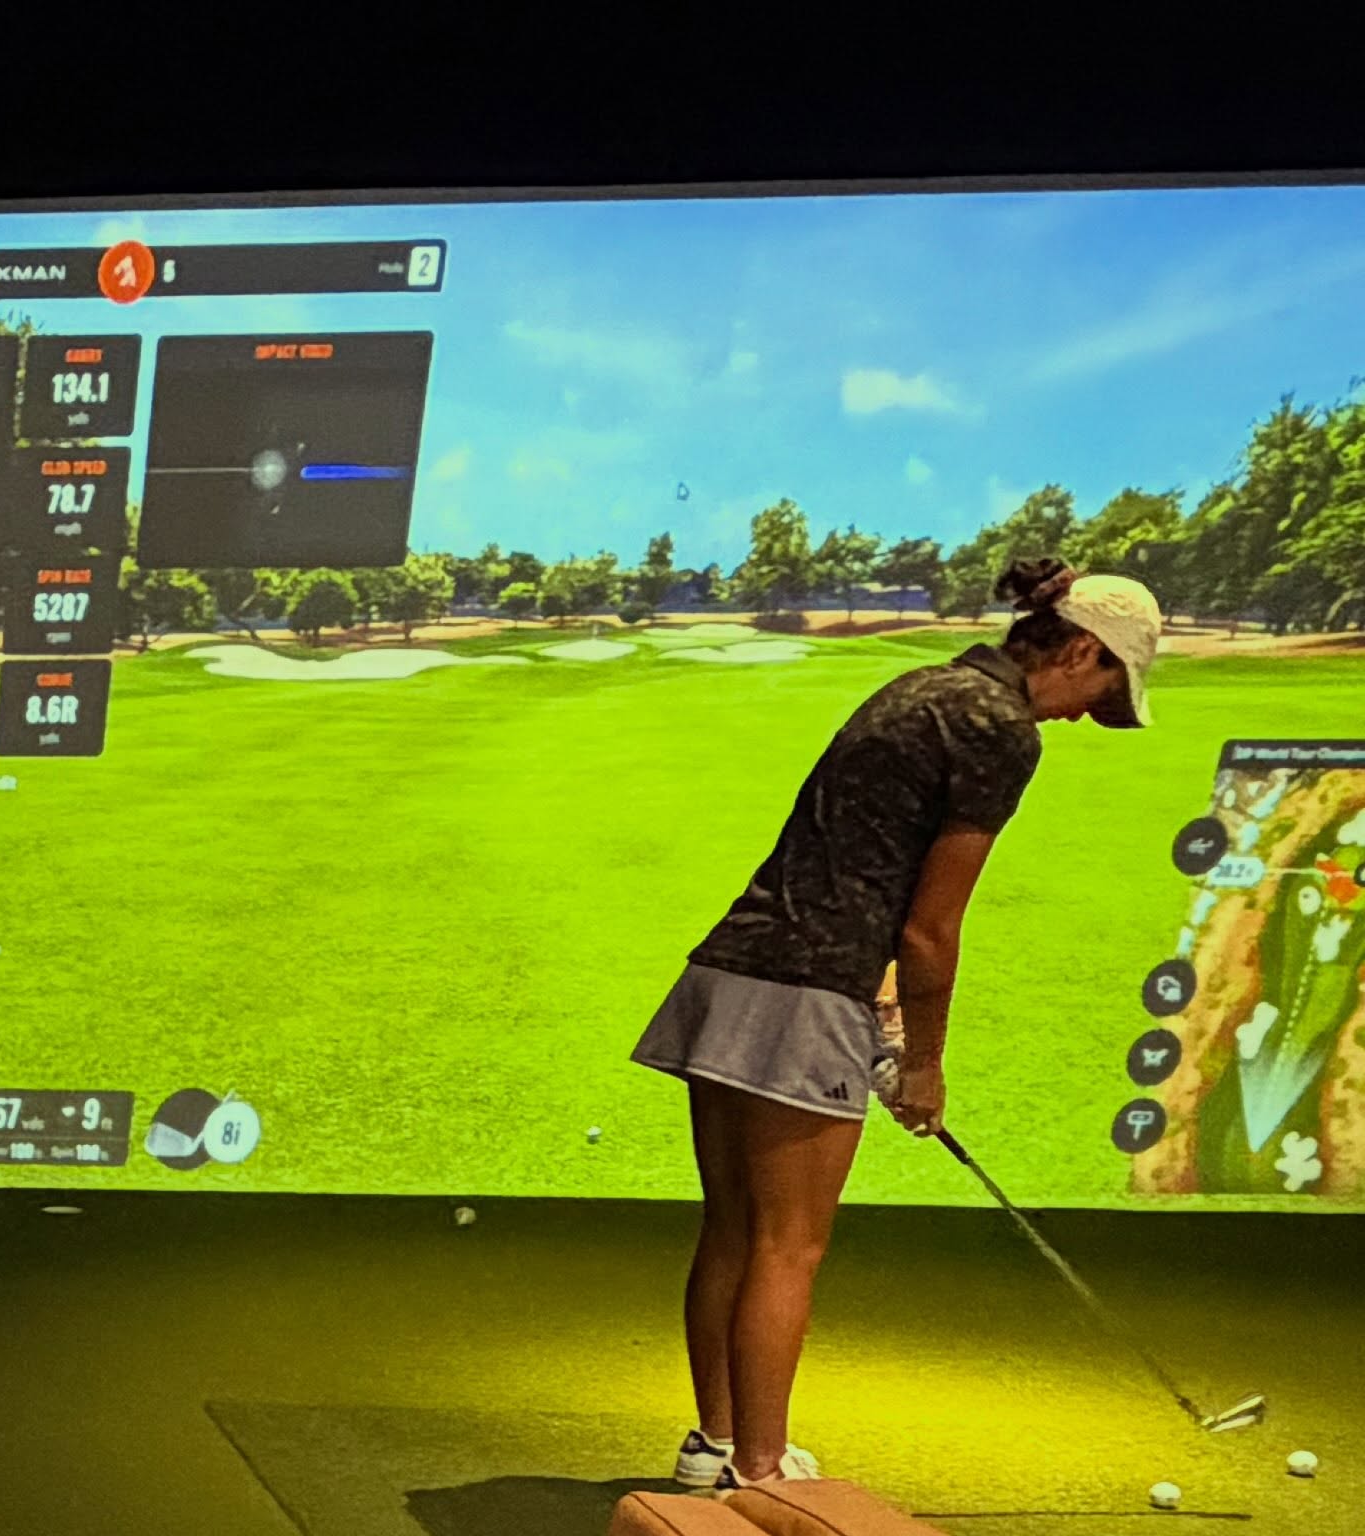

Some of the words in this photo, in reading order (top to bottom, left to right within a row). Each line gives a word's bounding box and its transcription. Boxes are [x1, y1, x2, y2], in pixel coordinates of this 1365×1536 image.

[418, 252, 432, 276] 2
[52, 372, 110, 404] 134.1
[47, 483, 96, 515] 78.7
[33, 592, 90, 623] 5287
[81, 1098, 101, 1130] 9
